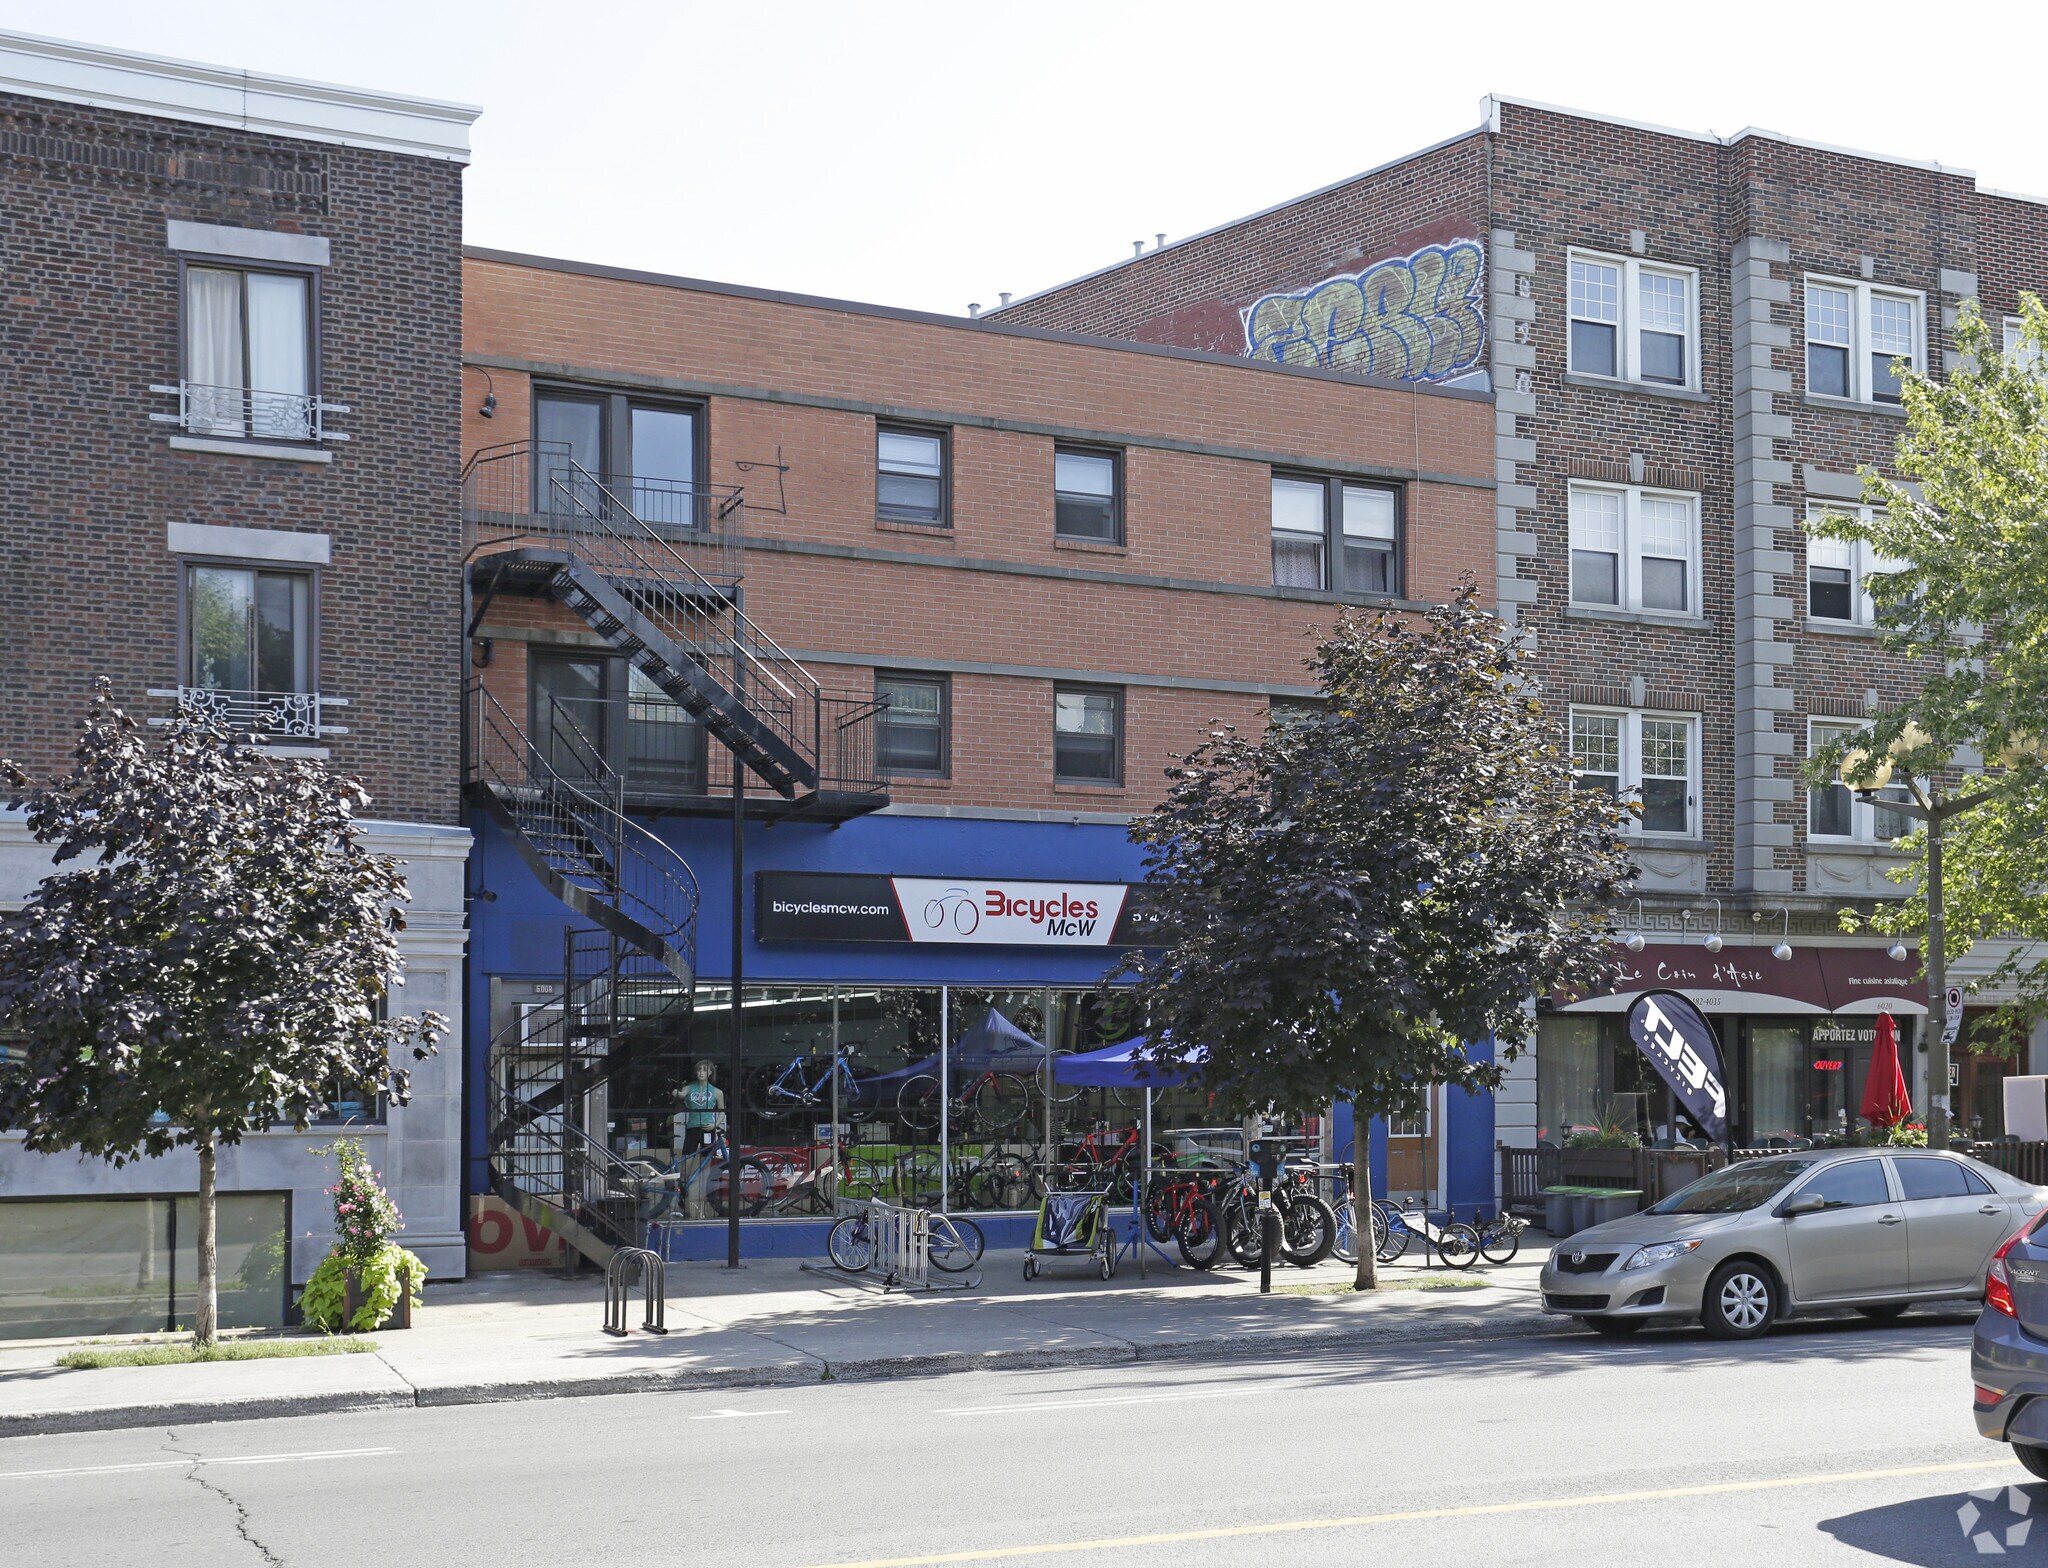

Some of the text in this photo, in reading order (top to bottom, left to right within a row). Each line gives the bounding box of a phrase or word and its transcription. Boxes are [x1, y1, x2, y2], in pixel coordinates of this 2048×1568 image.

[773, 901, 889, 915] bicyclesmcw.com
[985, 890, 1098, 924] Bicycles
[1046, 919, 1096, 936] McW
[1613, 961, 1642, 980] Le
[1848, 977, 1861, 985] Fine
[1862, 977, 1882, 985] cuisine
[1877, 1002, 1893, 1010] 6020
[1812, 1029, 1855, 1041] APPORTEZ
[1815, 1061, 1843, 1070] OUVERT
